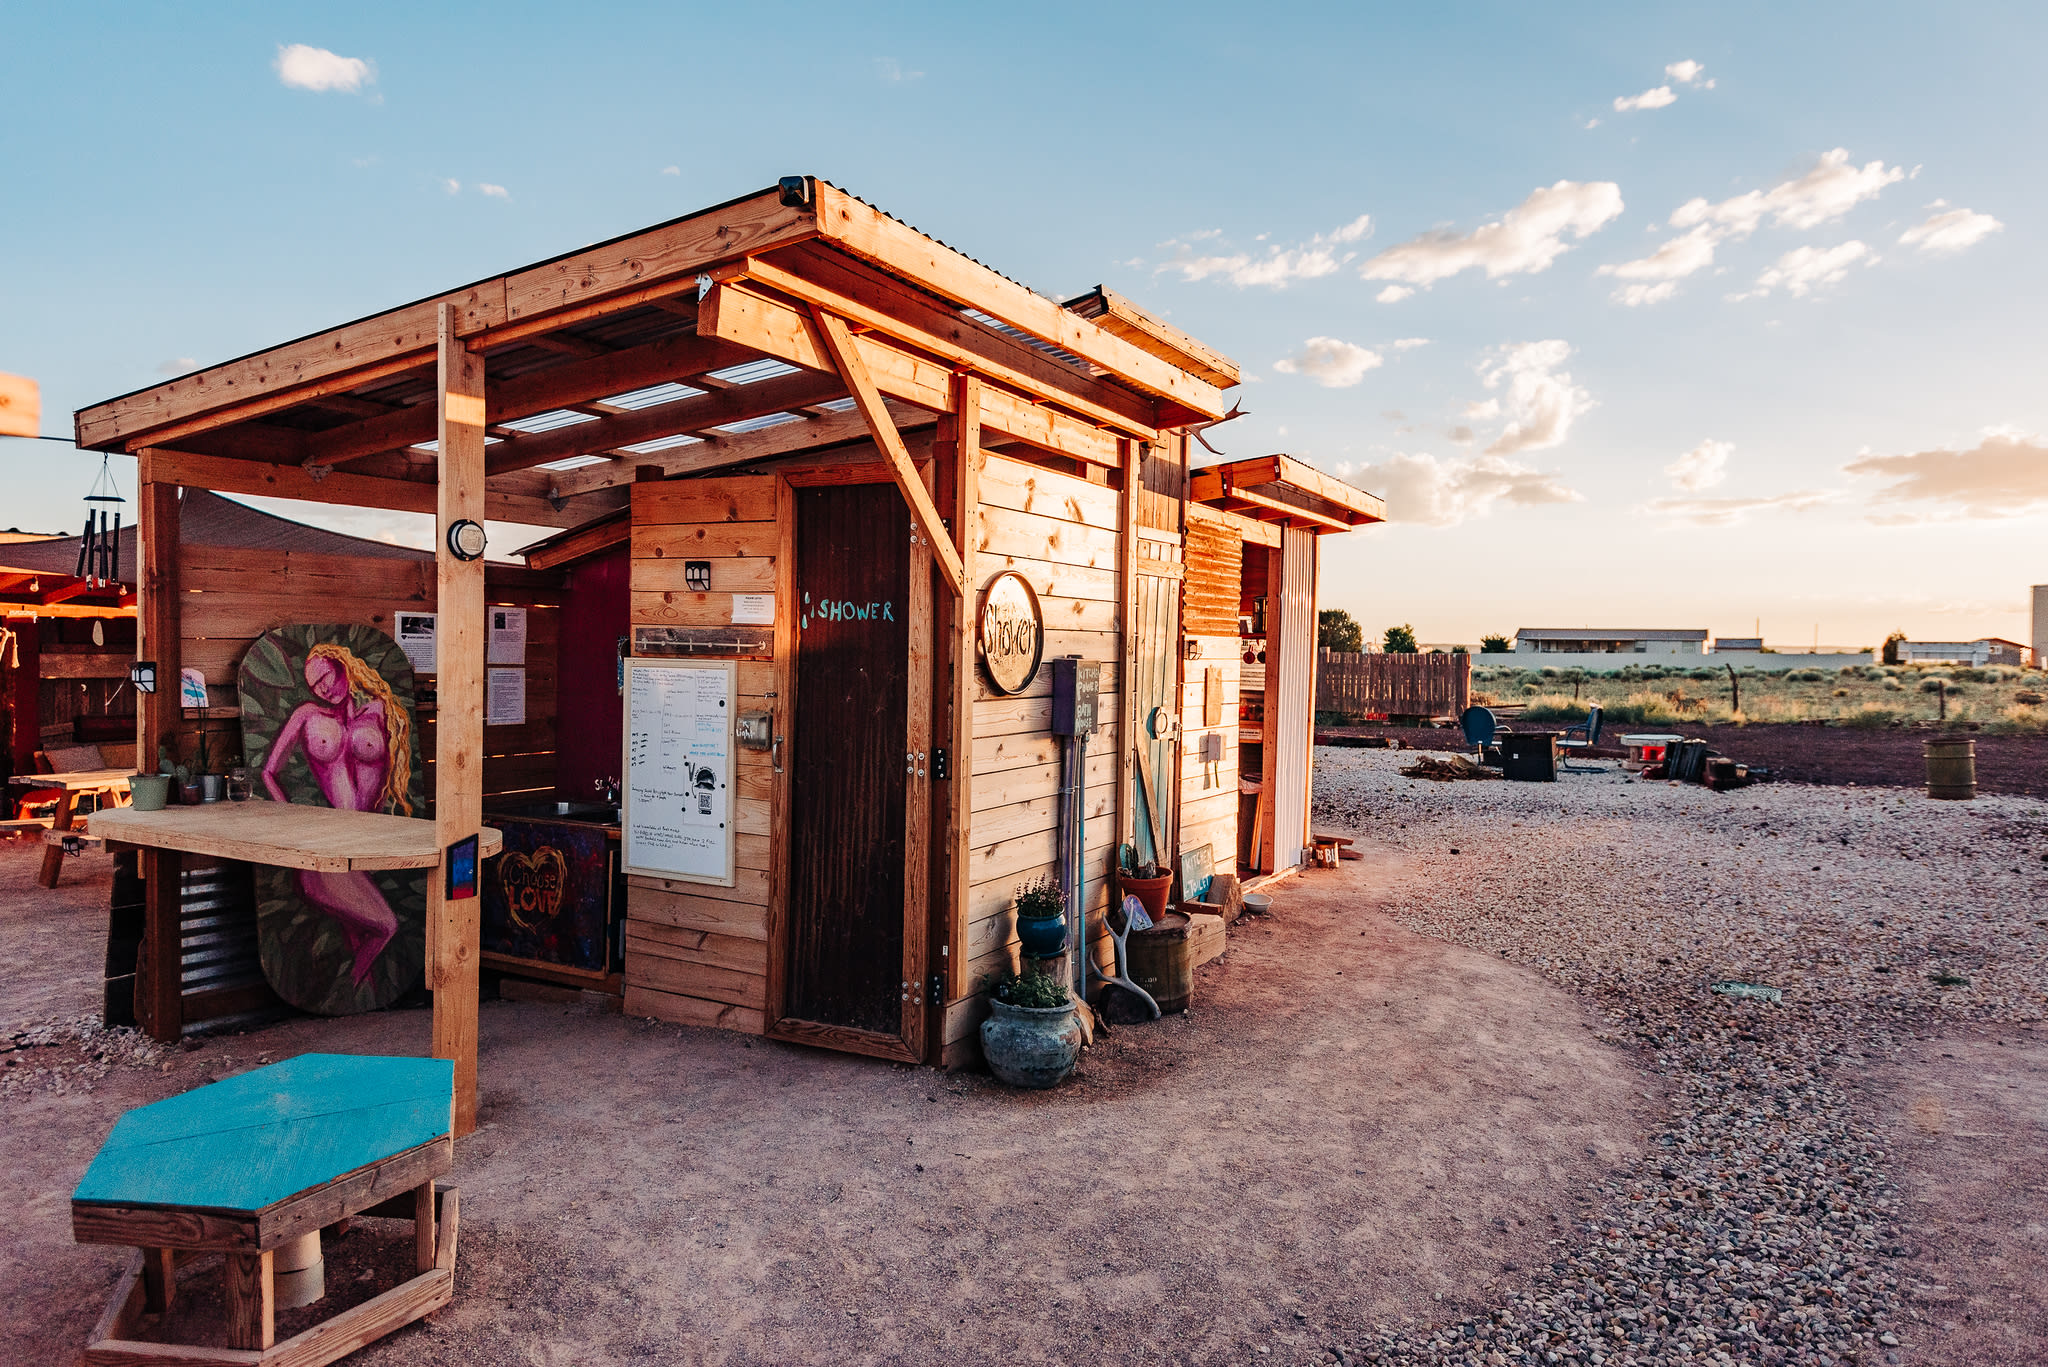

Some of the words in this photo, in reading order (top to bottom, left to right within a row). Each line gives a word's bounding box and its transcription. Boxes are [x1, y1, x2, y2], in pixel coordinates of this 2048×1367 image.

[817, 598, 894, 622] SHOWER
[986, 603, 1036, 657] Shower
[509, 863, 556, 889] Choose
[508, 885, 561, 916] LOVE
